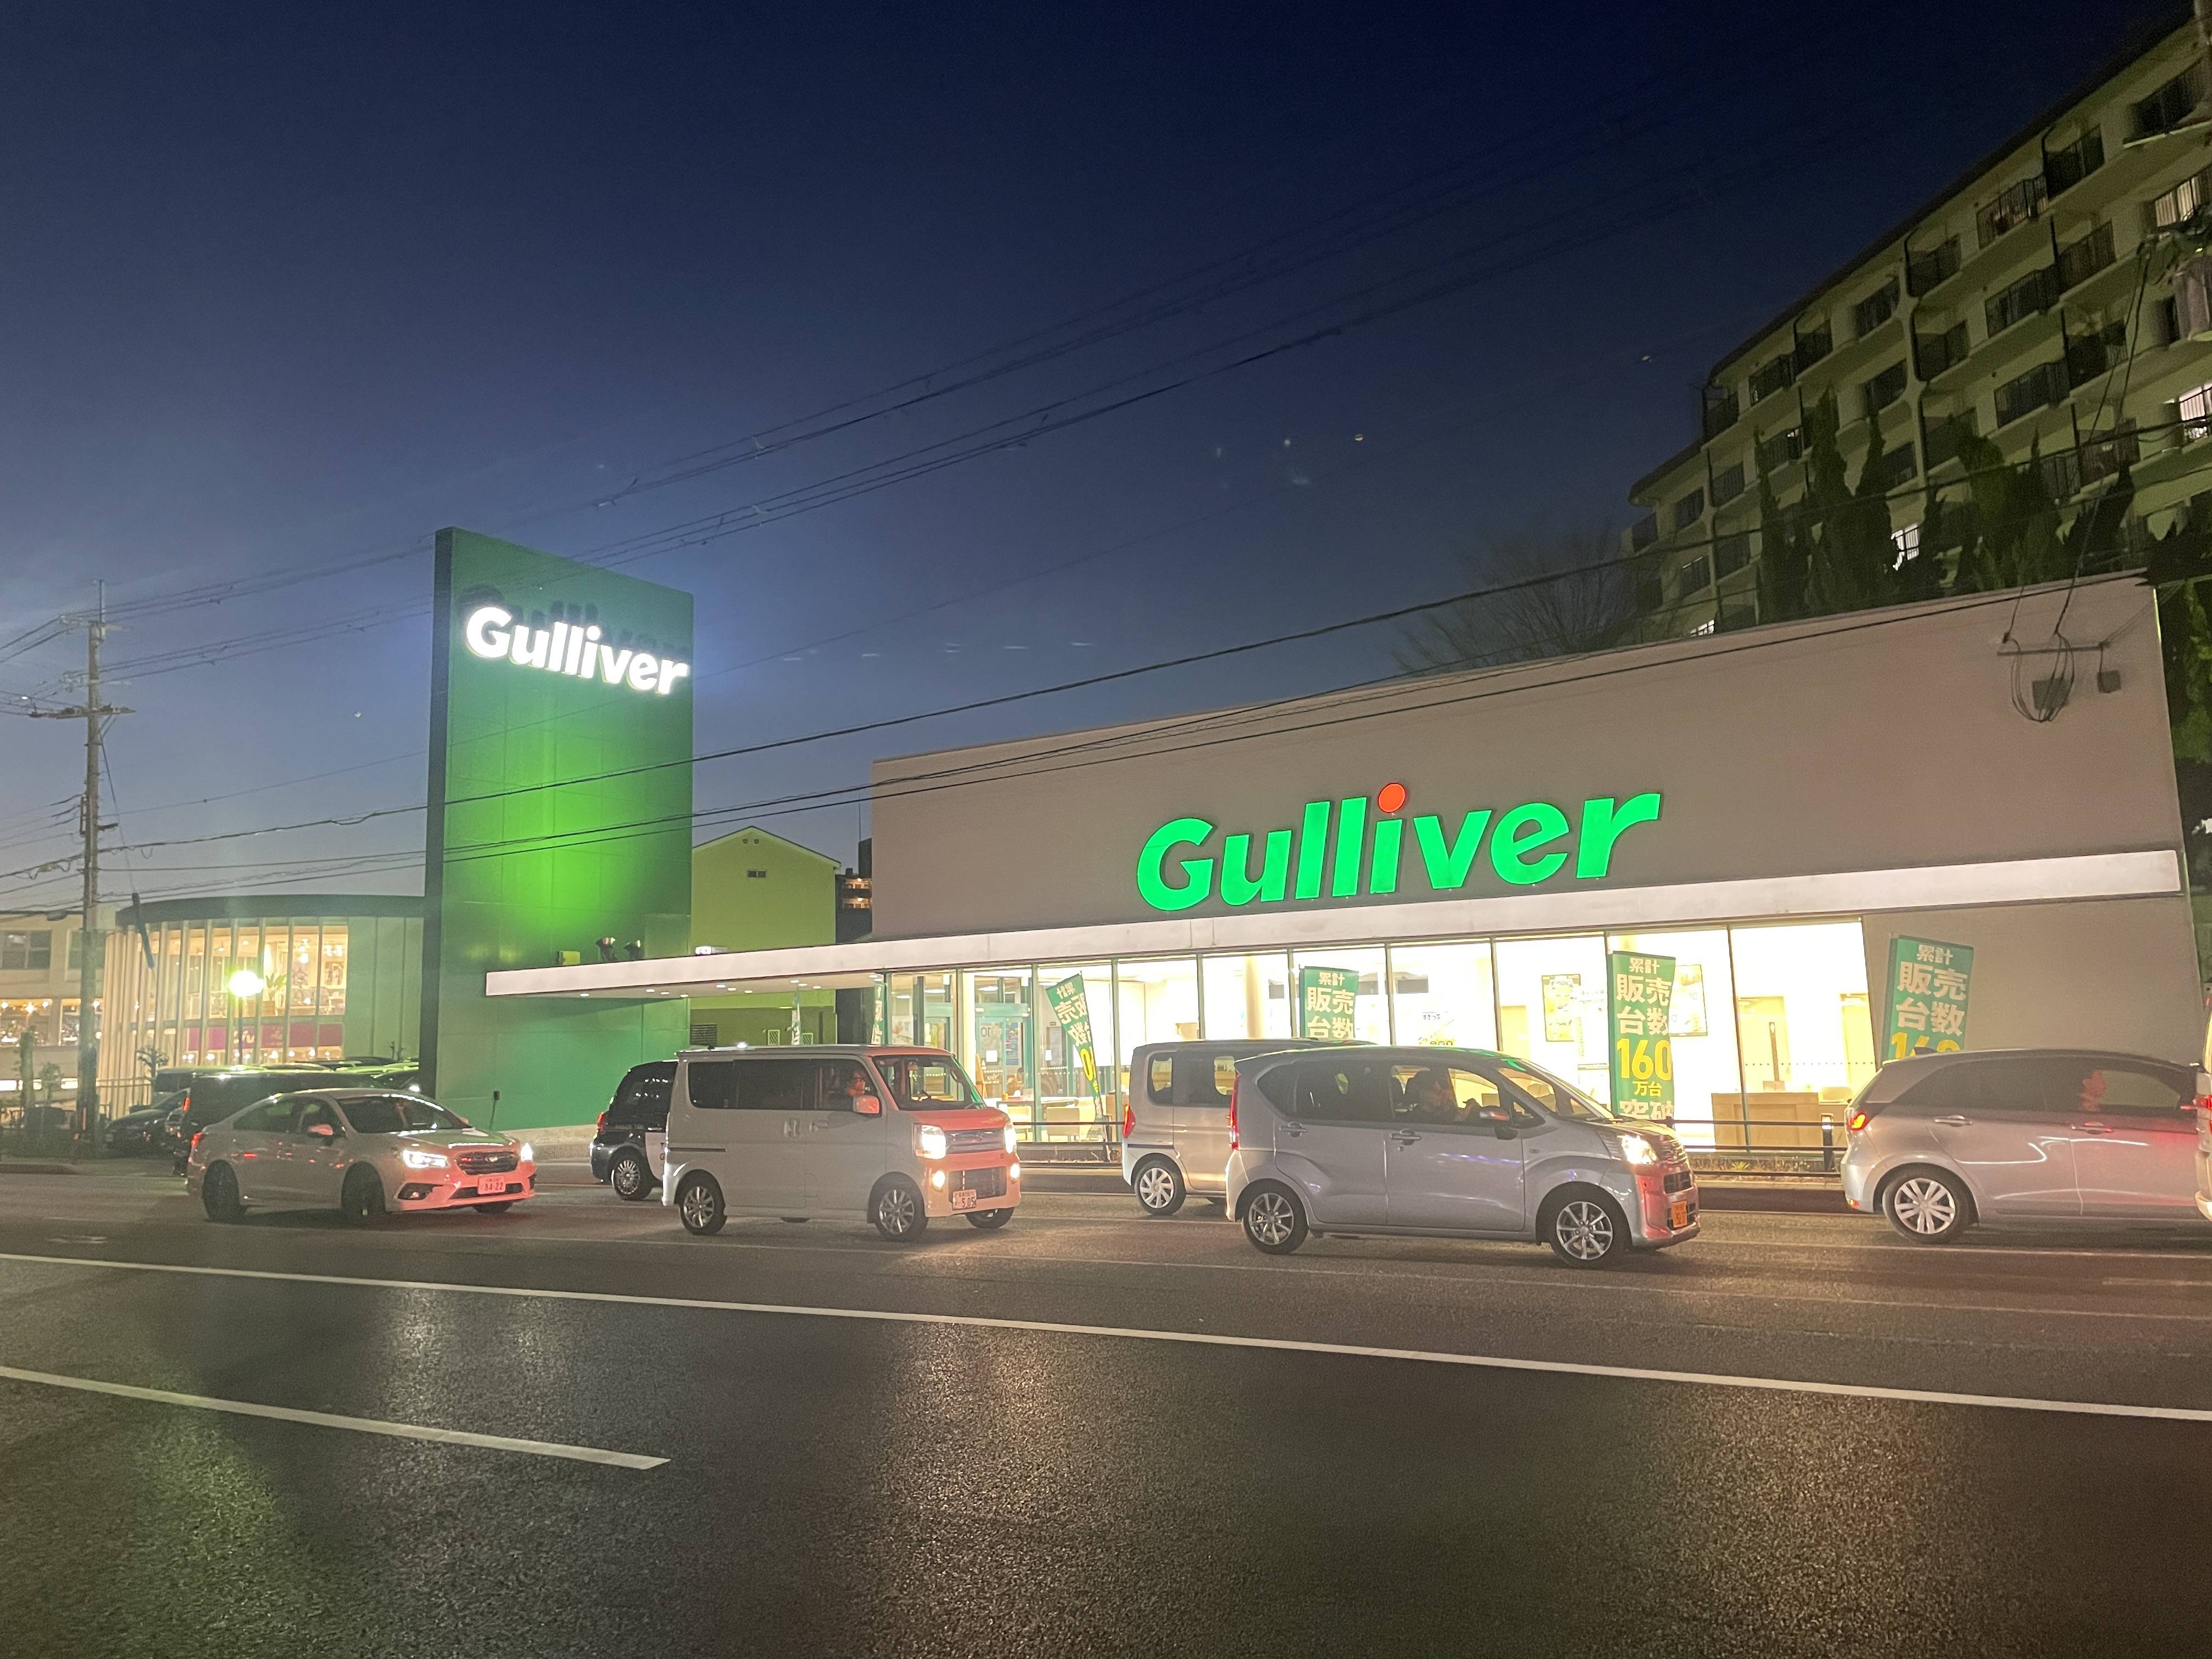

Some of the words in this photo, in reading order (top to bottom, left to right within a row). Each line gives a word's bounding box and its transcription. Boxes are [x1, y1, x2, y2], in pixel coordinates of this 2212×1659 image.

[466, 606, 691, 695] Gulliver
[1137, 782, 1661, 911] Gulliver
[1629, 957, 1660, 974] 累計
[1917, 945, 1953, 965] 累計
[1318, 972, 1345, 986] 累計
[1616, 974, 1672, 1006] 販売
[1897, 961, 1967, 1001] 販売
[1307, 986, 1355, 1015] 販売
[1307, 1015, 1354, 1040] 台数
[1617, 1006, 1669, 1036] 台数
[1896, 997, 1965, 1036] 台数
[1617, 1038, 1673, 1081] 160
[1632, 1081, 1662, 1097] 万台
